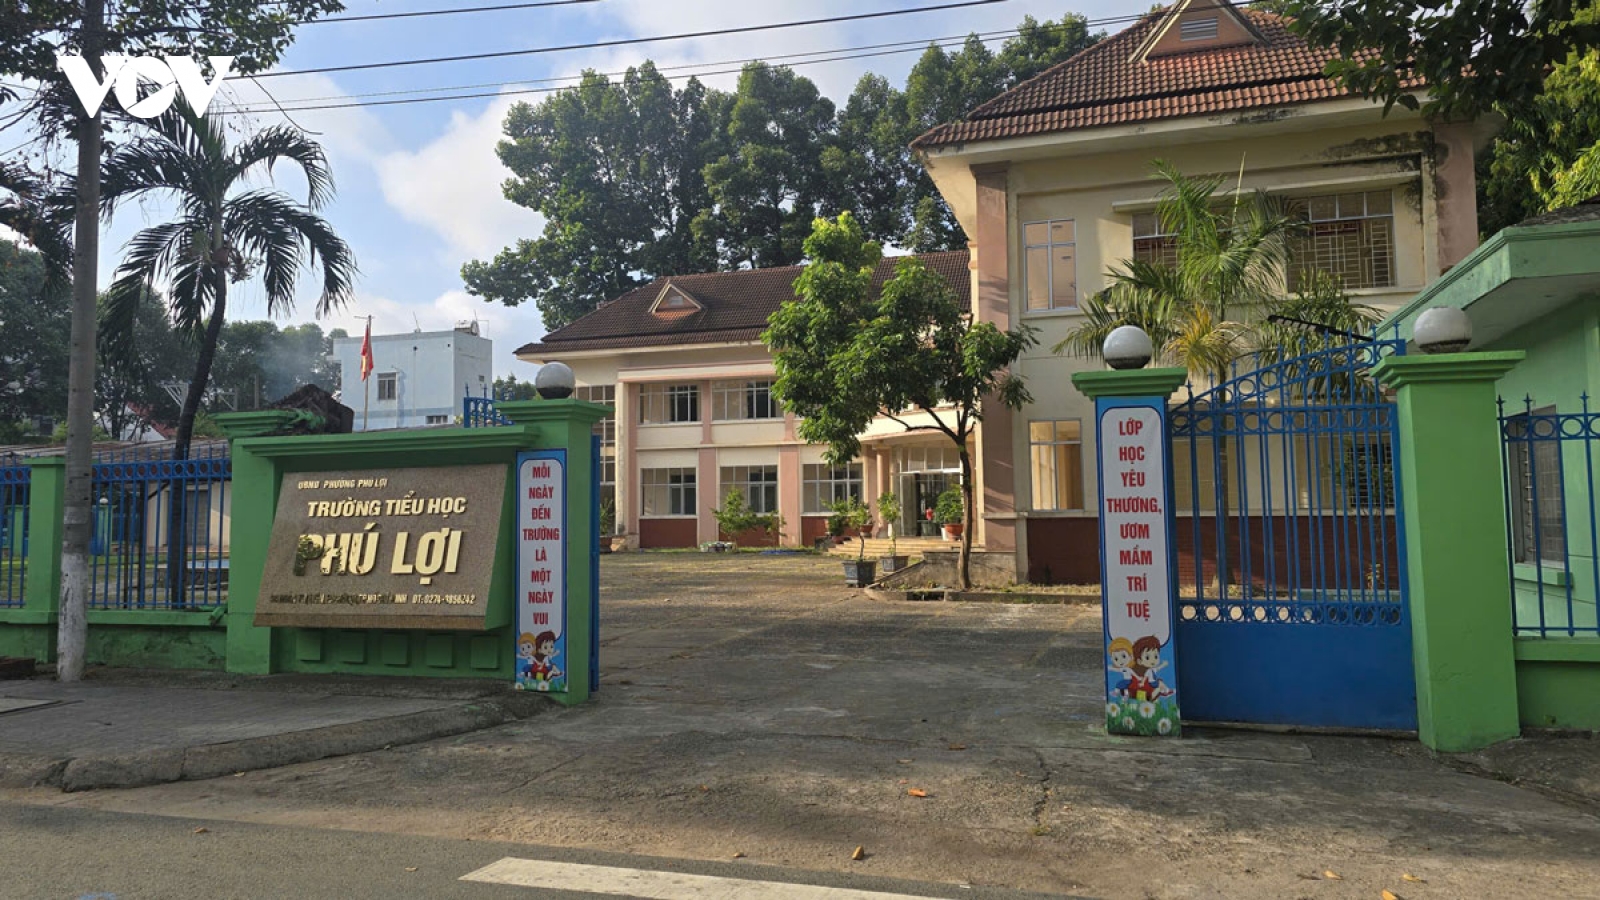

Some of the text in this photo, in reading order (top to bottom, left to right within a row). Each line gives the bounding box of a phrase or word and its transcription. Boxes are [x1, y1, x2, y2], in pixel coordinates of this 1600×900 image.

[1118, 417, 1143, 436] LỚP
[1119, 446, 1145, 465] HỌC
[532, 461, 551, 478] MỖI
[1120, 468, 1145, 487] YÊU
[528, 484, 554, 500] NGÀY
[308, 490, 467, 518] TRƯỜNG TIỂU HỌC
[531, 503, 551, 520] ĐẾN
[1106, 496, 1162, 514] THƯƠNG,
[522, 525, 560, 541] TRƯỜNG
[1119, 523, 1150, 539] ƯƠM
[293, 522, 463, 585] PHÚ LỢI
[535, 546, 548, 562] LÀ
[531, 567, 552, 586] MỘT
[1126, 572, 1148, 592] TRÍ
[527, 588, 554, 604] NGÀY
[532, 612, 549, 625] VUI
[1126, 599, 1151, 622] TUỆ
